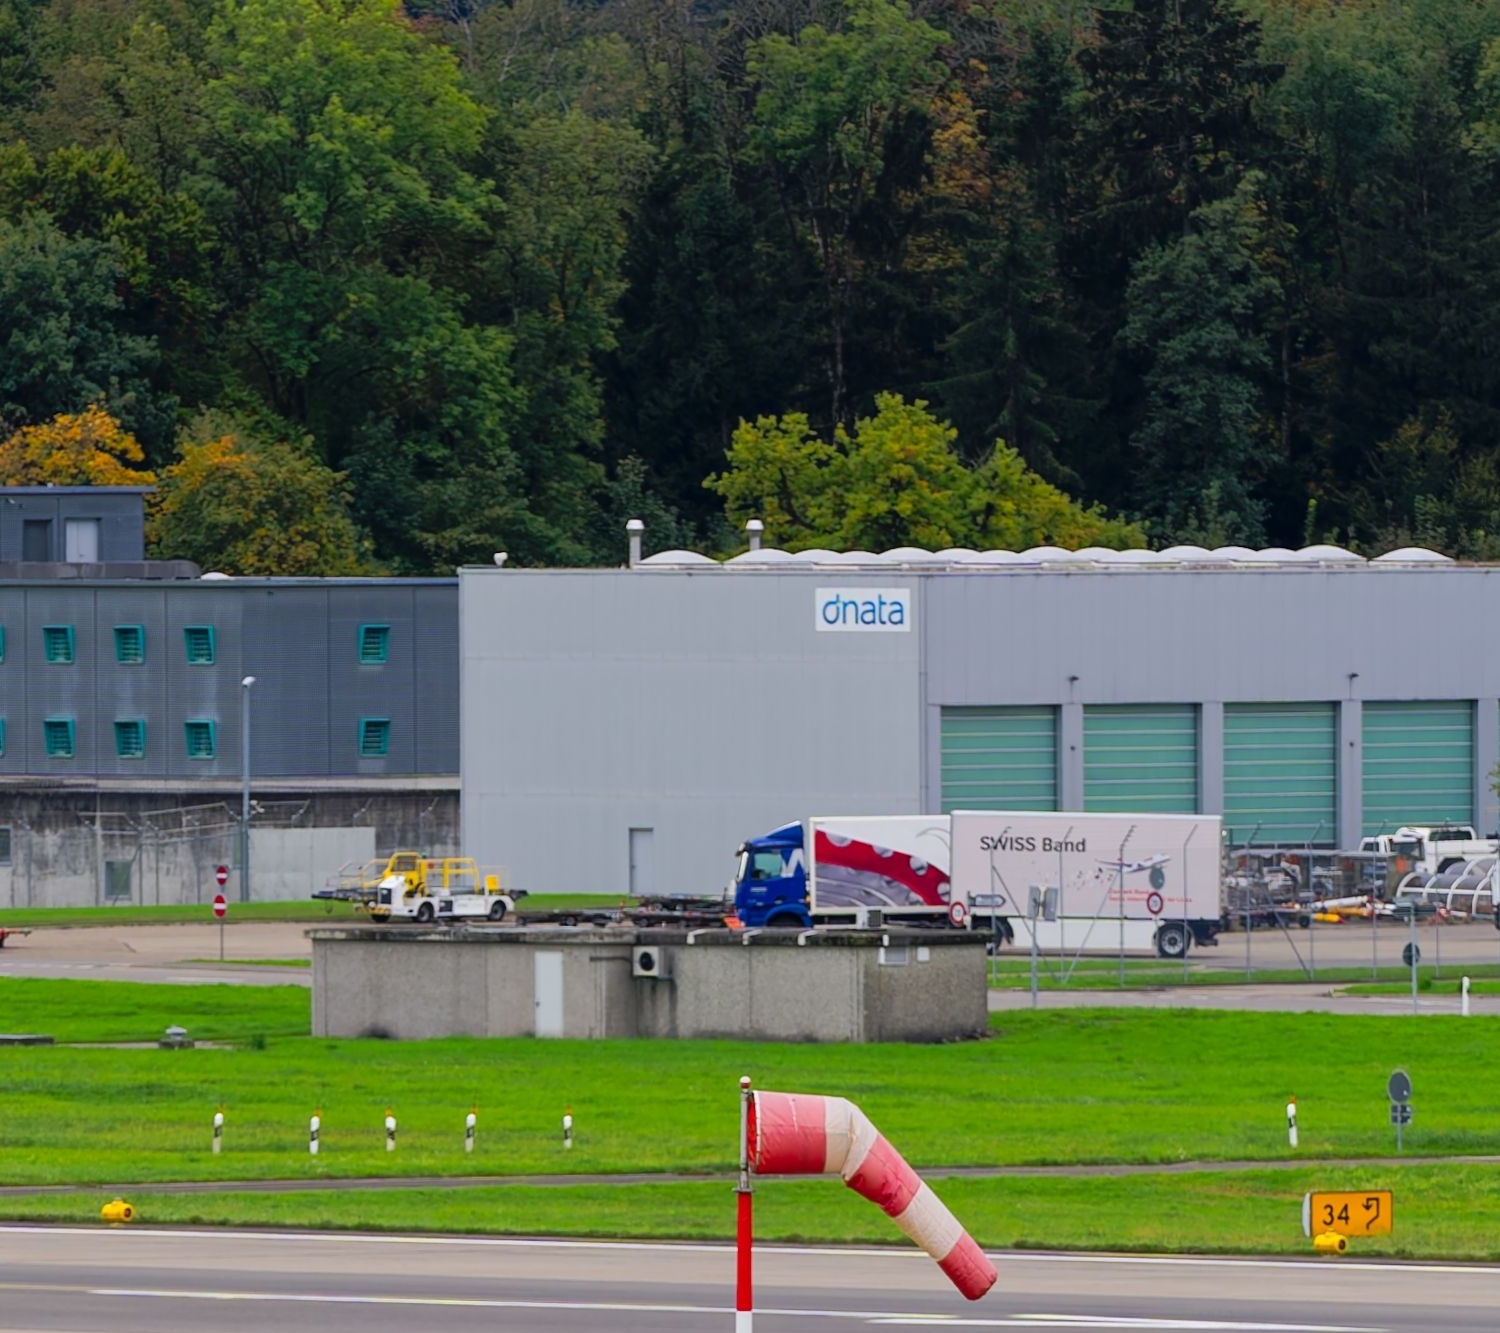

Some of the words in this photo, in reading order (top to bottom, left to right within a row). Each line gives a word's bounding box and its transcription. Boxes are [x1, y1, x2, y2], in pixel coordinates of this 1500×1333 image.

[822, 593, 904, 625] dnata
[980, 836, 1036, 852] SWISS
[1042, 837, 1086, 853] Band
[1322, 1203, 1350, 1226] 34
